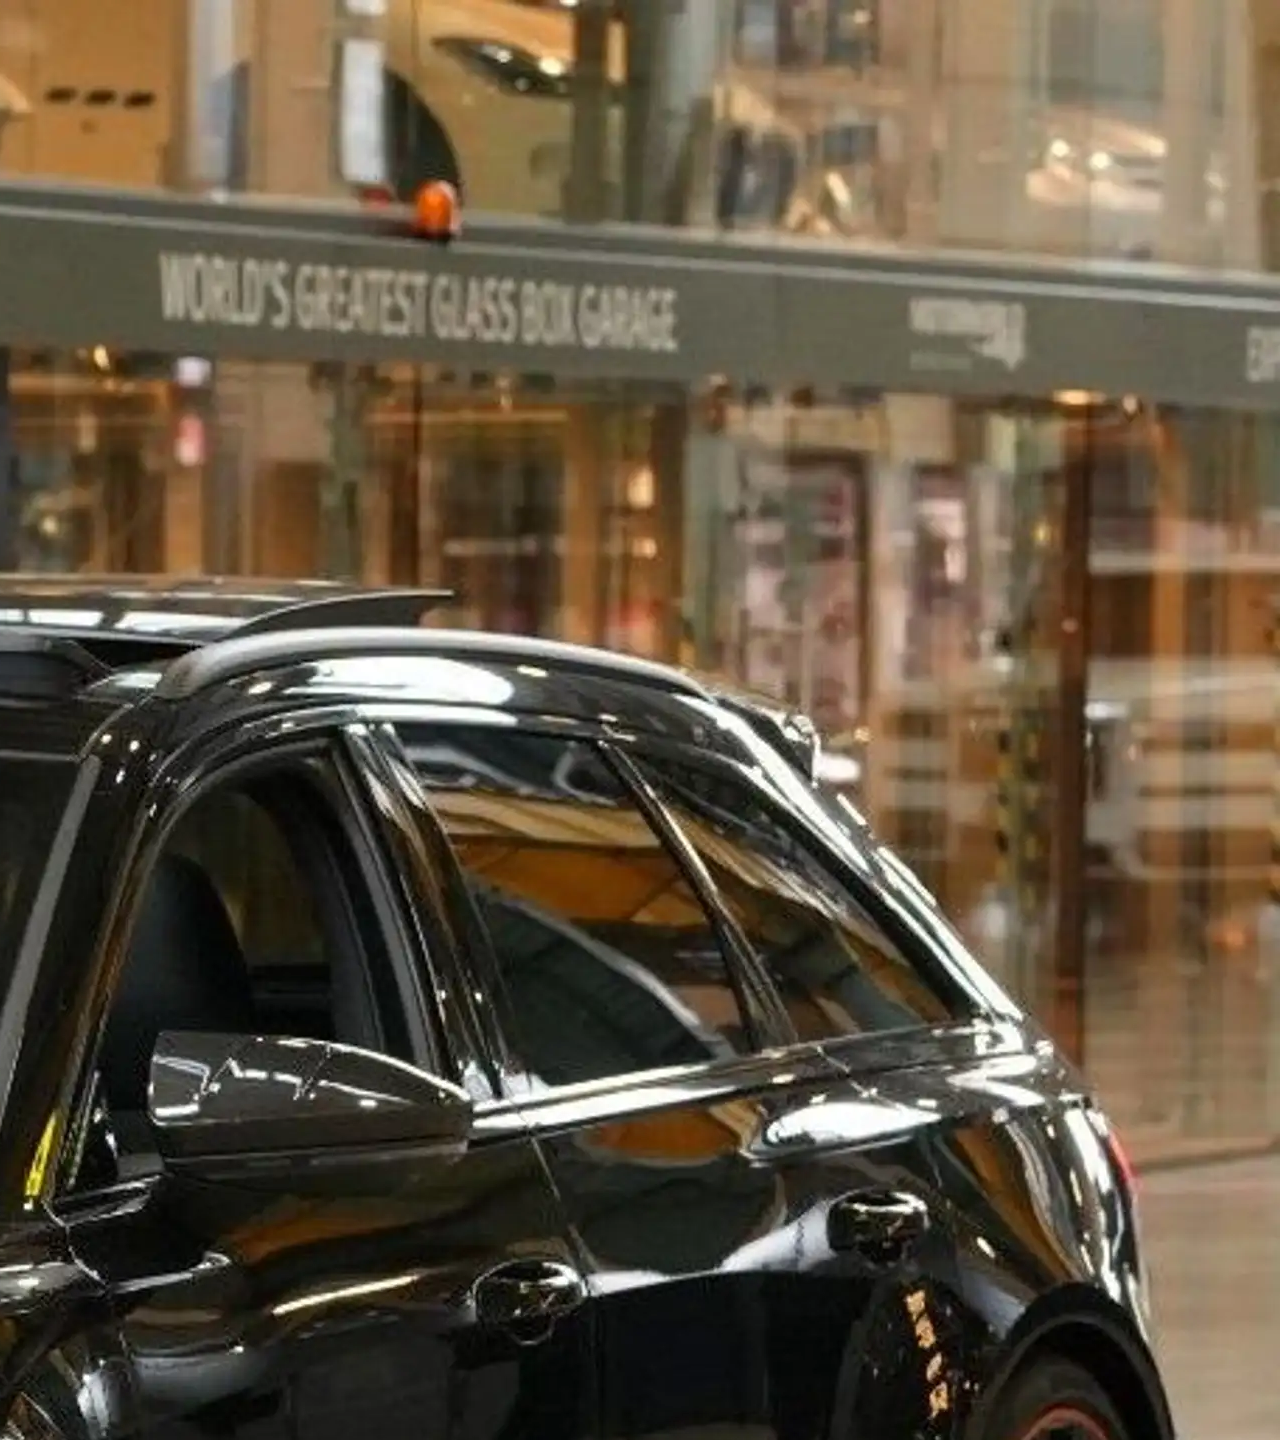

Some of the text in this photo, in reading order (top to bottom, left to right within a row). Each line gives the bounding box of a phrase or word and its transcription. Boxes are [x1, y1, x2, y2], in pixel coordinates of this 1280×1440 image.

[159, 253, 290, 330] WORLD'S
[294, 262, 429, 337] GREATEST
[431, 273, 518, 344] GLASS
